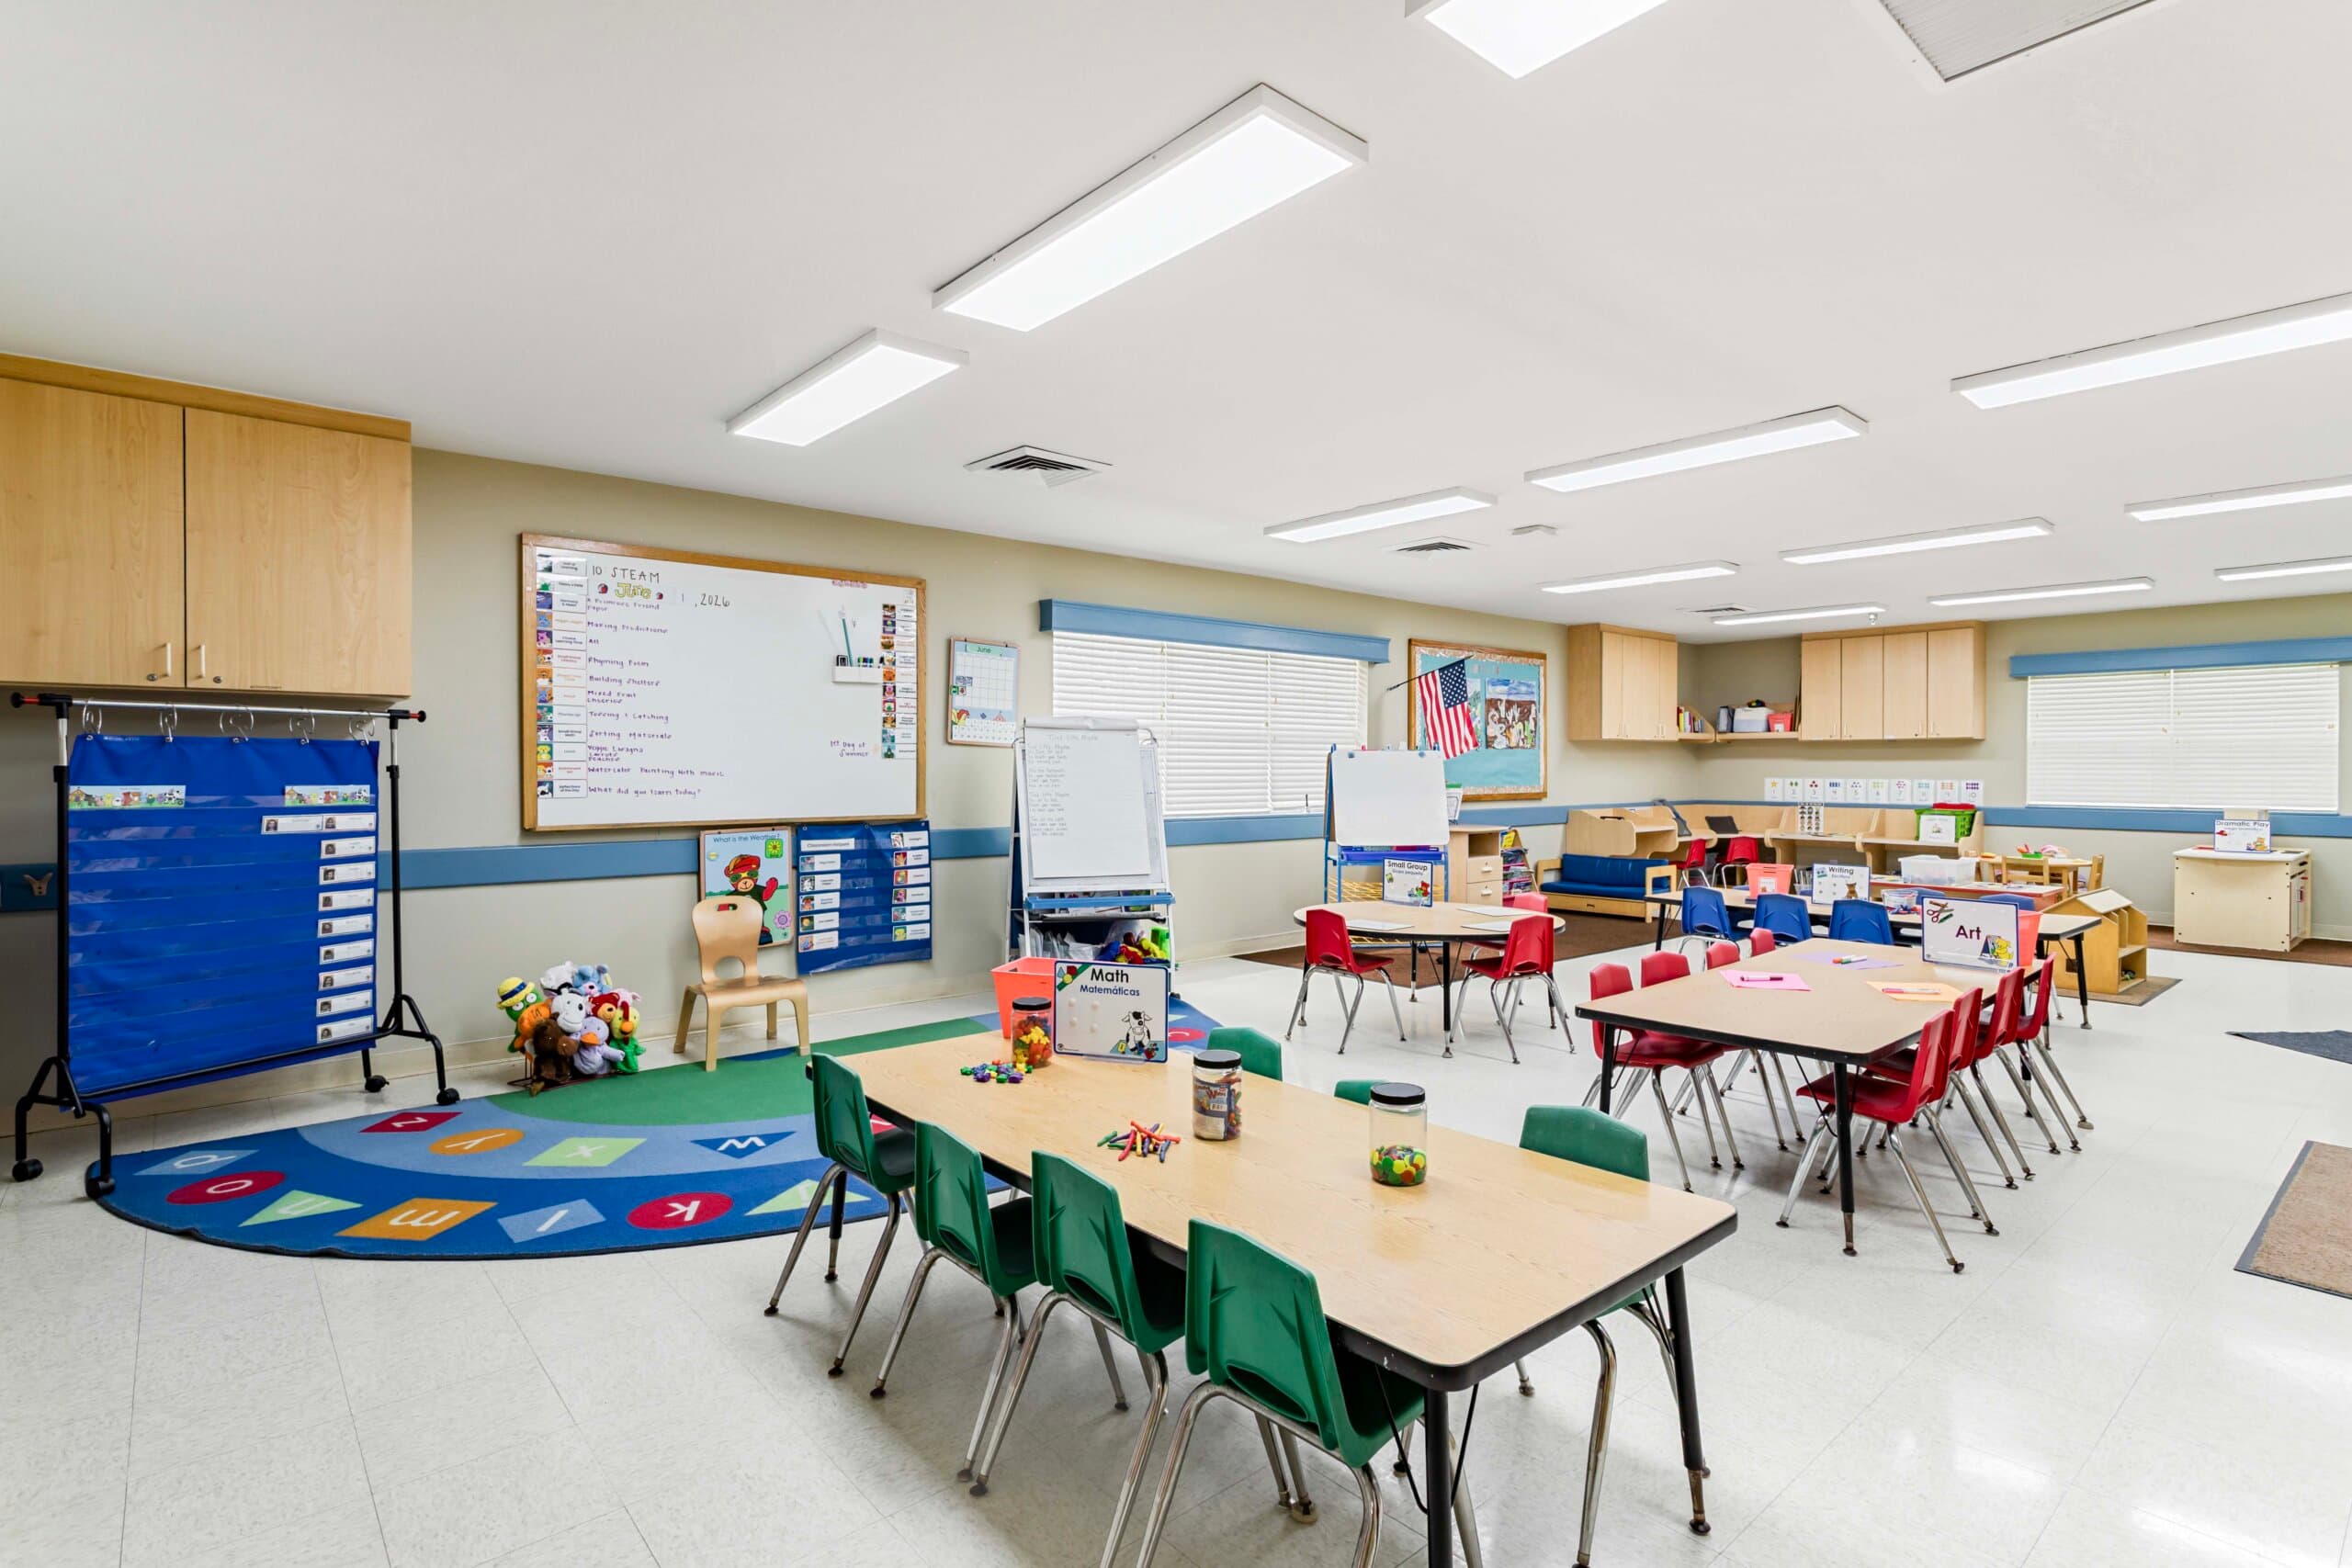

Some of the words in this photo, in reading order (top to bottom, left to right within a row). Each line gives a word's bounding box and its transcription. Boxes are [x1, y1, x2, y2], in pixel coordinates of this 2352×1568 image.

[592, 565, 603, 576] 10
[611, 567, 660, 584] STEAM
[615, 581, 651, 600] June
[587, 621, 617, 633] Making
[621, 624, 668, 634] Predictions
[977, 646, 991, 654] June
[588, 656, 624, 670] Rhyming
[589, 675, 623, 687] Building
[627, 678, 661, 687] Shelters
[588, 711, 619, 721] Tossing
[632, 712, 669, 725] Catching
[588, 729, 621, 741] Sorting
[628, 731, 673, 740] Materials
[842, 741, 855, 751] Day
[839, 748, 868, 758] Summer
[639, 766, 674, 780] Painting
[588, 785, 612, 794] What
[616, 787, 629, 795] did
[650, 788, 673, 796] learn
[713, 836, 731, 844] What
[1387, 860, 1406, 869] Small
[1407, 862, 1428, 872] Group
[1828, 865, 1854, 875] Writing
[1955, 924, 1982, 941] Art
[1090, 967, 1129, 984] Math
[1080, 984, 1140, 997] Matemáticas
